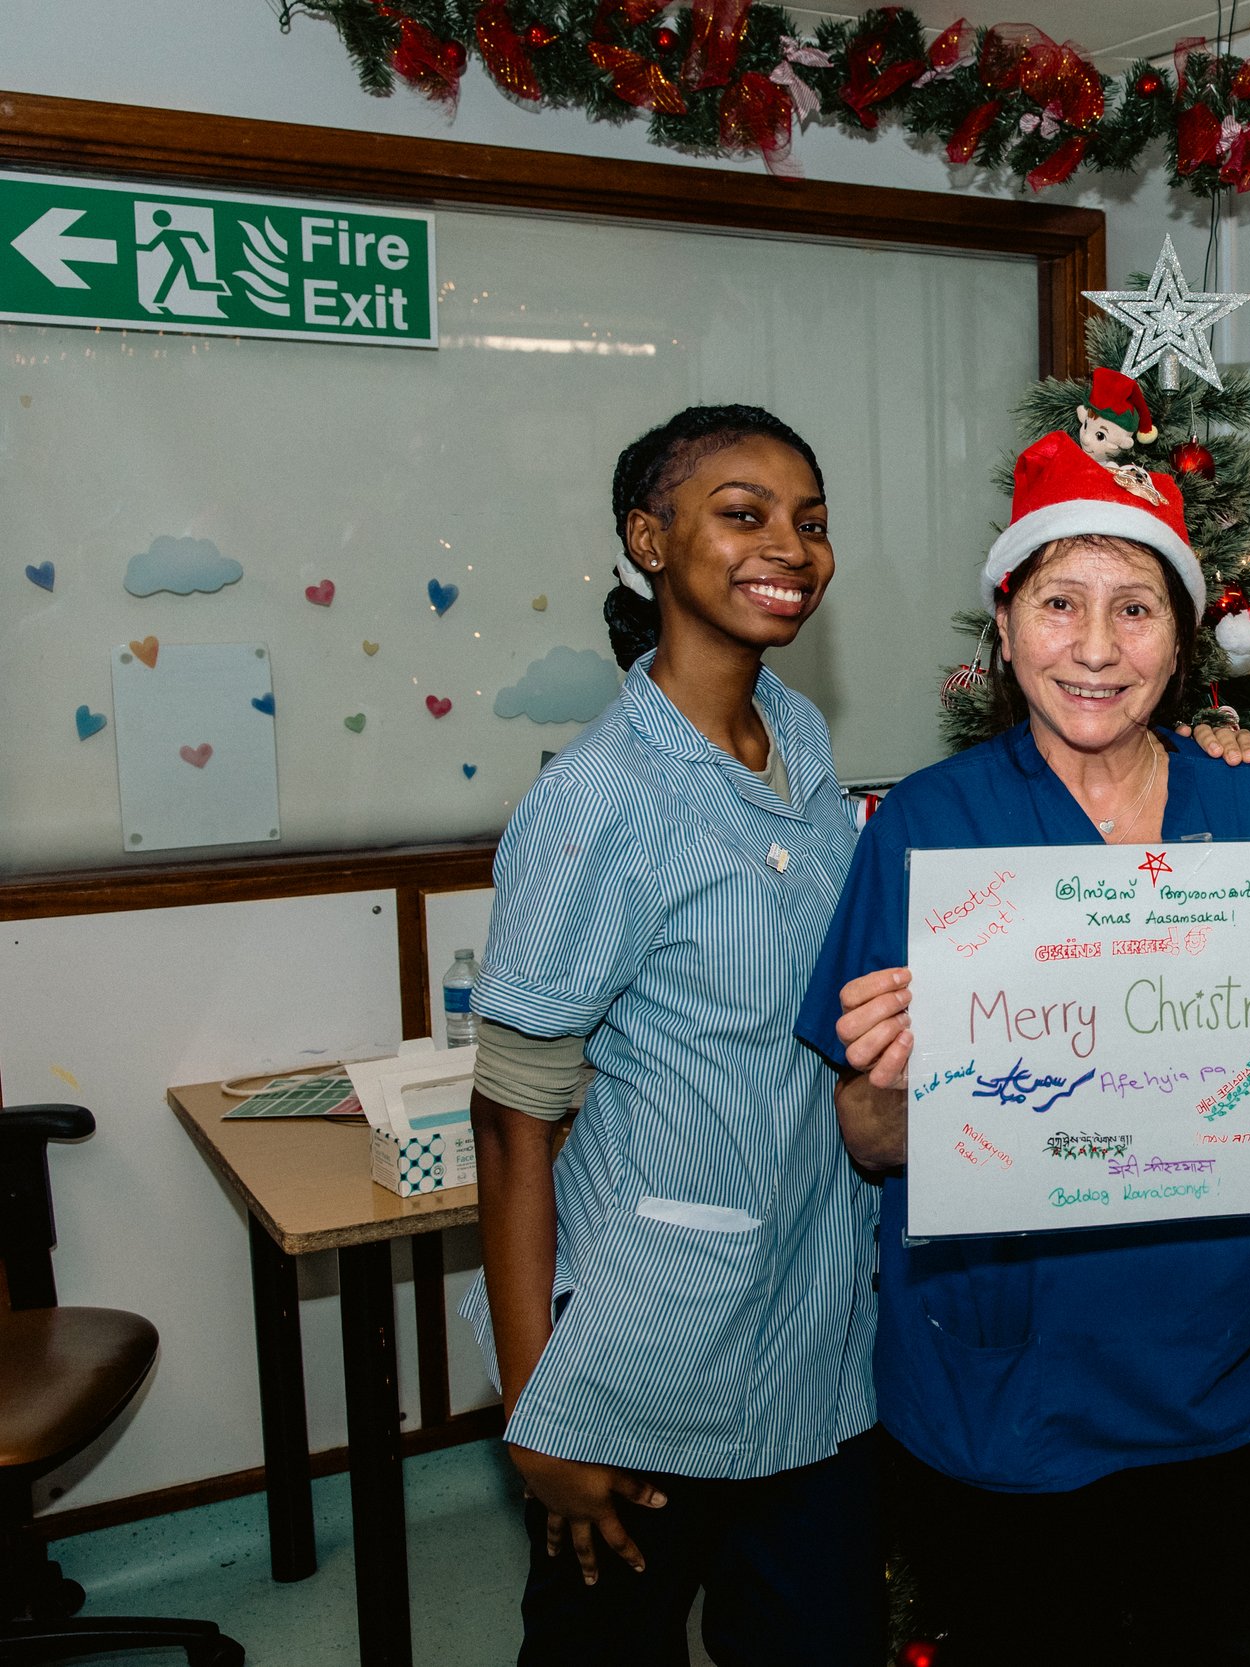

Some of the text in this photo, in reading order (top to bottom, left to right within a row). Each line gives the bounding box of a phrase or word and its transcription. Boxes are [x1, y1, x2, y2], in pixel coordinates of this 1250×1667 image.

[301, 216, 410, 270] Fire
[303, 278, 409, 331] Exit
[1086, 912, 1131, 926] Xmas
[970, 990, 1096, 1058] Merry
[914, 1059, 976, 1101] Eid Said
[1196, 1096, 1217, 1114] 메리
[456, 1154, 475, 1164] Face
[962, 1123, 1013, 1170] Maligayang
[1048, 1187, 1109, 1207] Boldog
